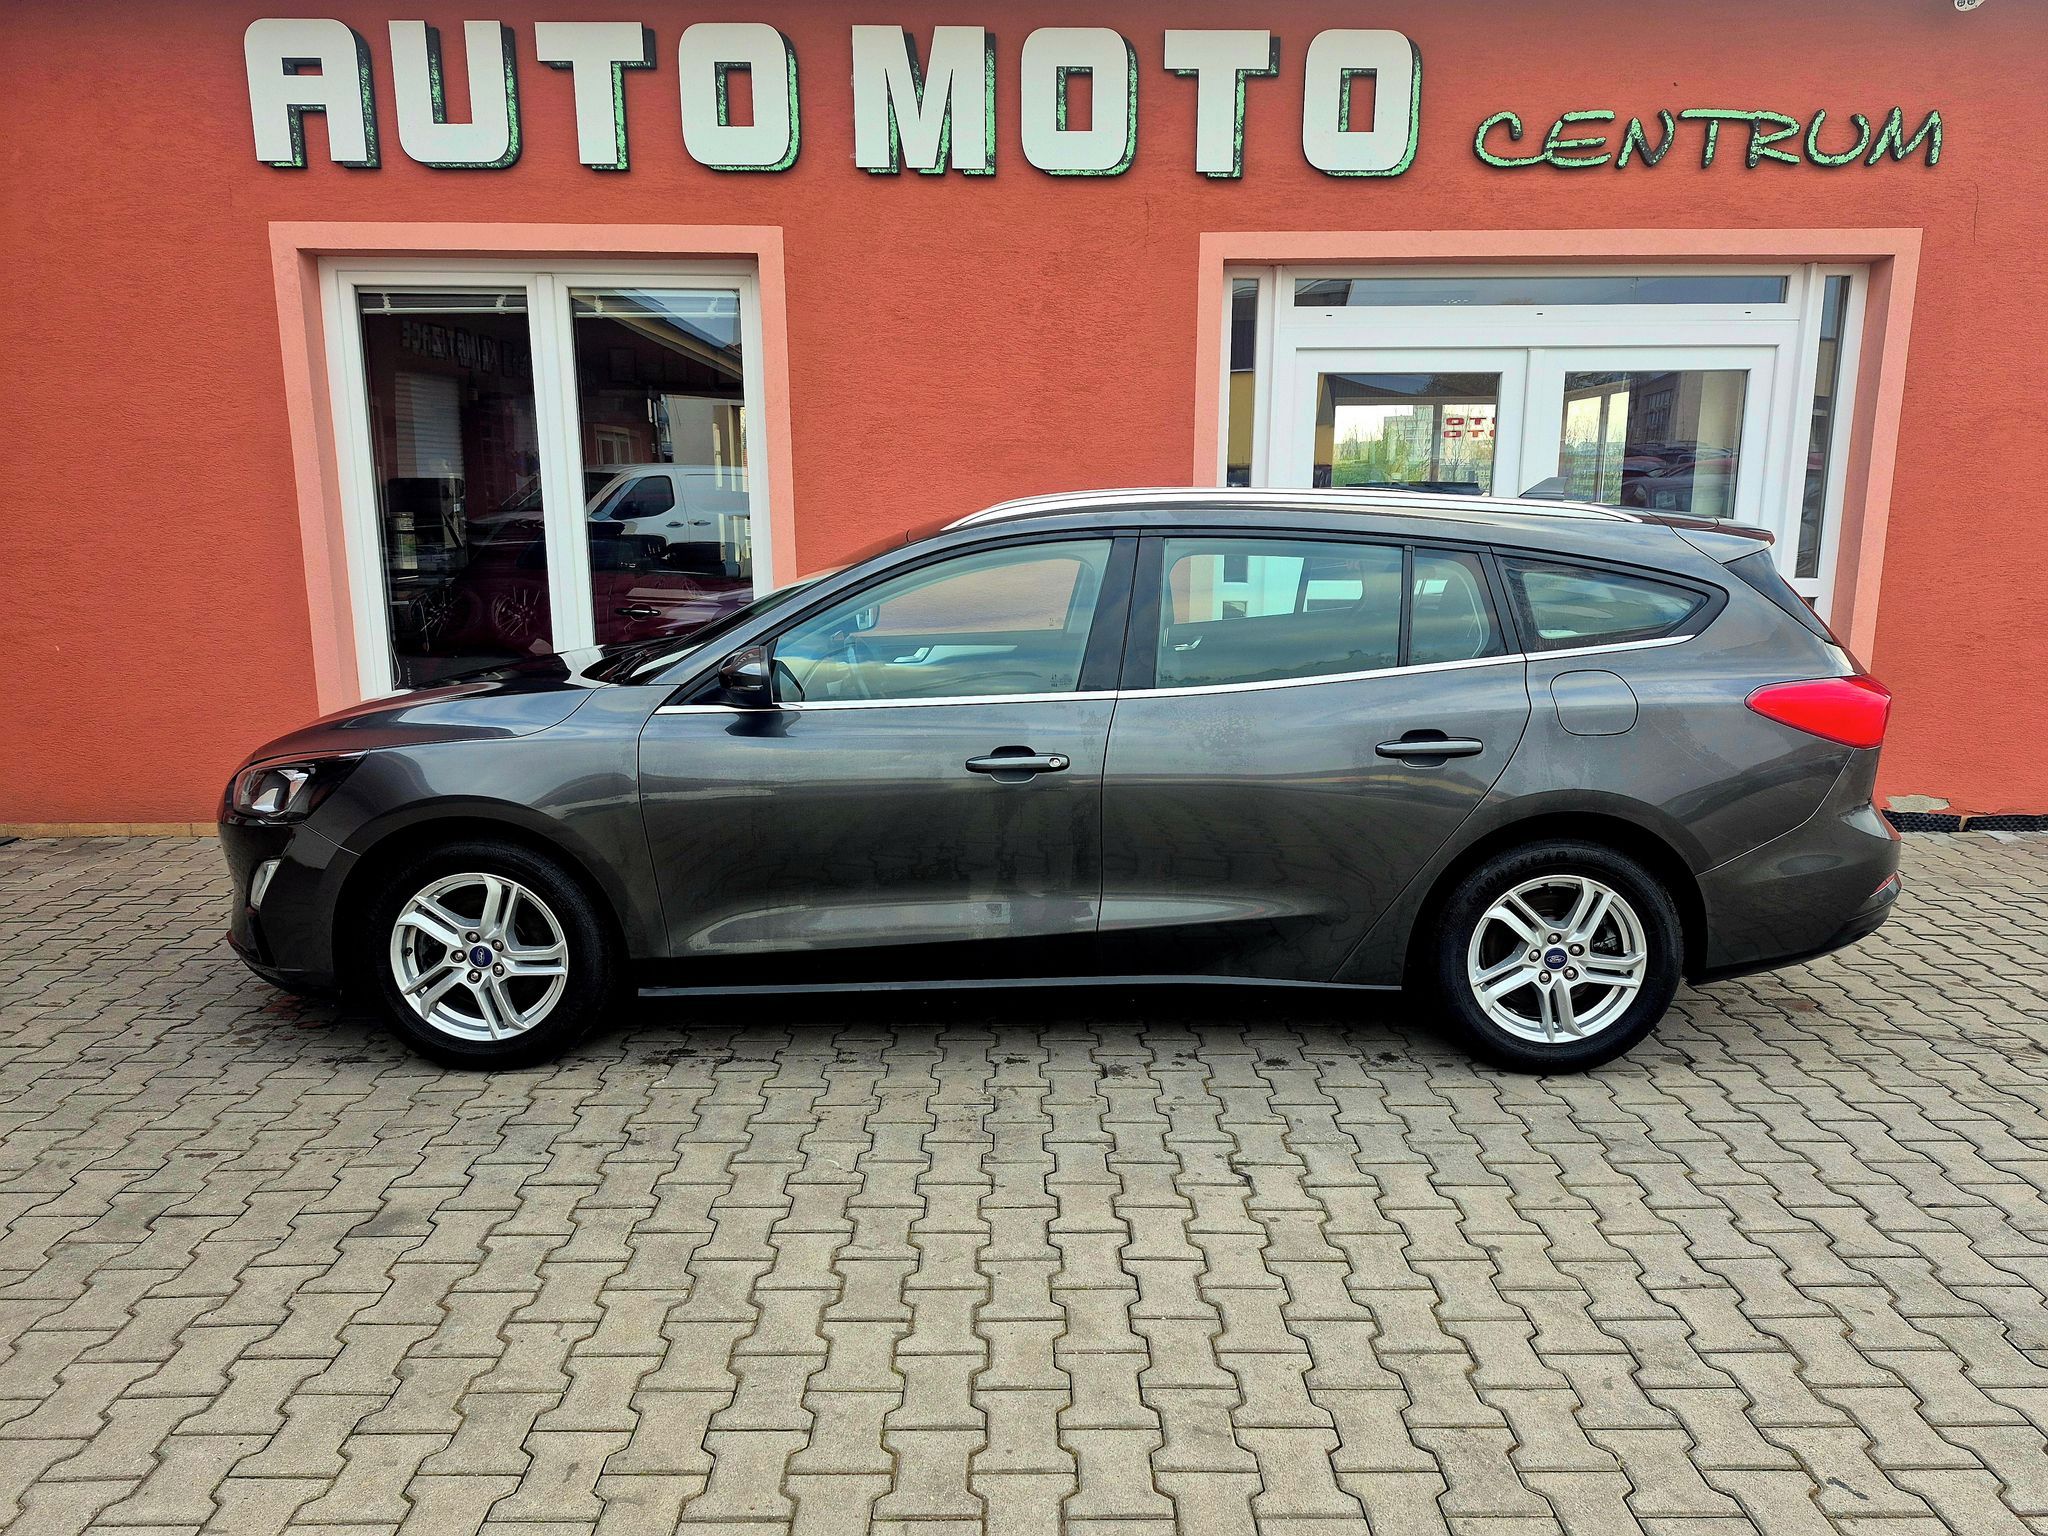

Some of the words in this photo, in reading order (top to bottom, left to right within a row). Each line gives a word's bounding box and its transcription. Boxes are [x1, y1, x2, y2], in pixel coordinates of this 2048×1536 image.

[243, 17, 801, 172] AUTO
[851, 24, 1423, 179] MOTO
[1473, 106, 1944, 169] CENTRUM
